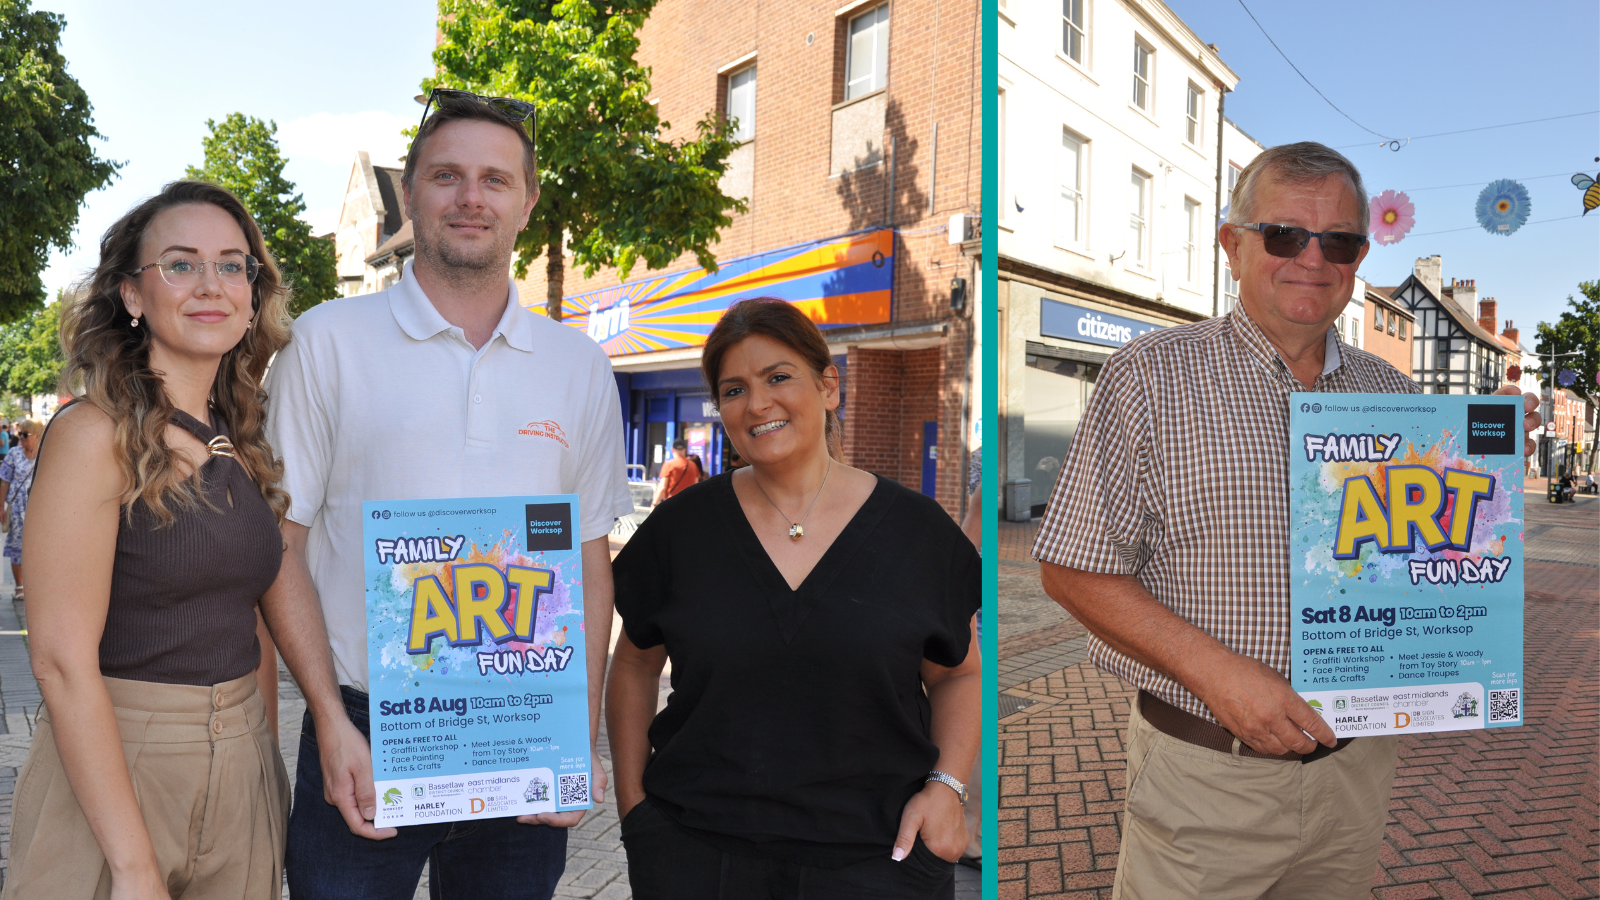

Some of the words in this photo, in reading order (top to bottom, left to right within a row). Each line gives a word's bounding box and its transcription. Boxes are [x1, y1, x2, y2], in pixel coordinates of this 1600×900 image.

[1077, 313, 1132, 343] citizens
[1324, 404, 1348, 412] follow
[1362, 404, 1436, 414] @discoverworksop
[544, 425, 555, 434] THE
[1472, 430, 1506, 438] Worksop
[394, 510, 416, 518] follow
[428, 508, 496, 518] @discoverworksop
[1332, 464, 1496, 560] ART
[530, 527, 563, 535] Worksop
[1408, 558, 1459, 586] FUN
[1460, 556, 1512, 583] DAY
[406, 562, 556, 656] ART
[1301, 607, 1336, 624] Sat
[1338, 605, 1352, 623] 8
[1354, 605, 1396, 626] Aug
[1400, 606, 1436, 620] 10am
[1439, 606, 1454, 618] to
[1456, 604, 1488, 620] 2pm
[1302, 630, 1346, 640] Bottom
[1350, 628, 1361, 638] of
[1364, 627, 1402, 640] Bridge
[1406, 626, 1420, 637] St,
[1422, 624, 1474, 636] Worksop
[1303, 648, 1326, 656] OPEN
[1336, 646, 1356, 654] FREE
[1420, 652, 1446, 660] Jessie
[1456, 650, 1484, 658] Woody
[476, 650, 524, 676] FUN
[525, 646, 574, 672] DAY
[1312, 656, 1340, 664] Graffiti
[1343, 654, 1385, 664] Workshop
[1334, 664, 1370, 674] Painting
[1399, 662, 1419, 670] from
[1421, 662, 1436, 670] Toy
[1438, 660, 1458, 668] Story
[1312, 676, 1330, 684] Arts
[1340, 674, 1366, 682] Crafts
[1398, 672, 1425, 680] Dance
[1427, 670, 1460, 678] Troupes
[1507, 671, 1516, 680] for
[1506, 678, 1518, 686] info
[1350, 694, 1390, 704] Bassetlaw
[1412, 690, 1448, 699] midlands
[380, 698, 412, 716] Sat
[414, 697, 426, 714] 8
[428, 696, 468, 716] Aug
[470, 696, 506, 709] 10am
[507, 694, 522, 706] to
[524, 692, 553, 708] 2pm
[1392, 700, 1429, 708] chamber
[380, 721, 422, 732] Bottom
[425, 718, 436, 728] of
[438, 716, 474, 728] Bridge
[476, 715, 490, 726] St,
[492, 712, 541, 724] Worksop
[1336, 715, 1368, 724] HARLEY
[1412, 714, 1444, 722] ASSOCIATES
[1336, 722, 1386, 732] FOUNDATION
[1412, 720, 1434, 728] LIMITED
[382, 738, 404, 746] OPEN
[412, 736, 431, 744] FREE
[472, 740, 490, 748] Meet
[492, 738, 516, 746] Jessie
[525, 736, 552, 744] Woody
[390, 746, 418, 754] Graffiti
[420, 744, 459, 752] Workshop
[472, 749, 491, 757] from
[492, 748, 506, 756] Toy
[508, 747, 528, 755] Story
[392, 756, 410, 764] Face
[412, 753, 445, 762] Painting
[472, 758, 497, 766] Dance
[499, 756, 530, 764] Troupes
[560, 756, 574, 764] Scan
[576, 756, 584, 764] for
[417, 762, 442, 770] Crafts
[574, 762, 586, 770] info
[486, 776, 520, 784] midlands
[428, 782, 464, 790] Bassetlaw
[468, 785, 502, 794] chamber
[414, 802, 446, 810] HARLEY
[414, 808, 462, 818] FOUNDATION
